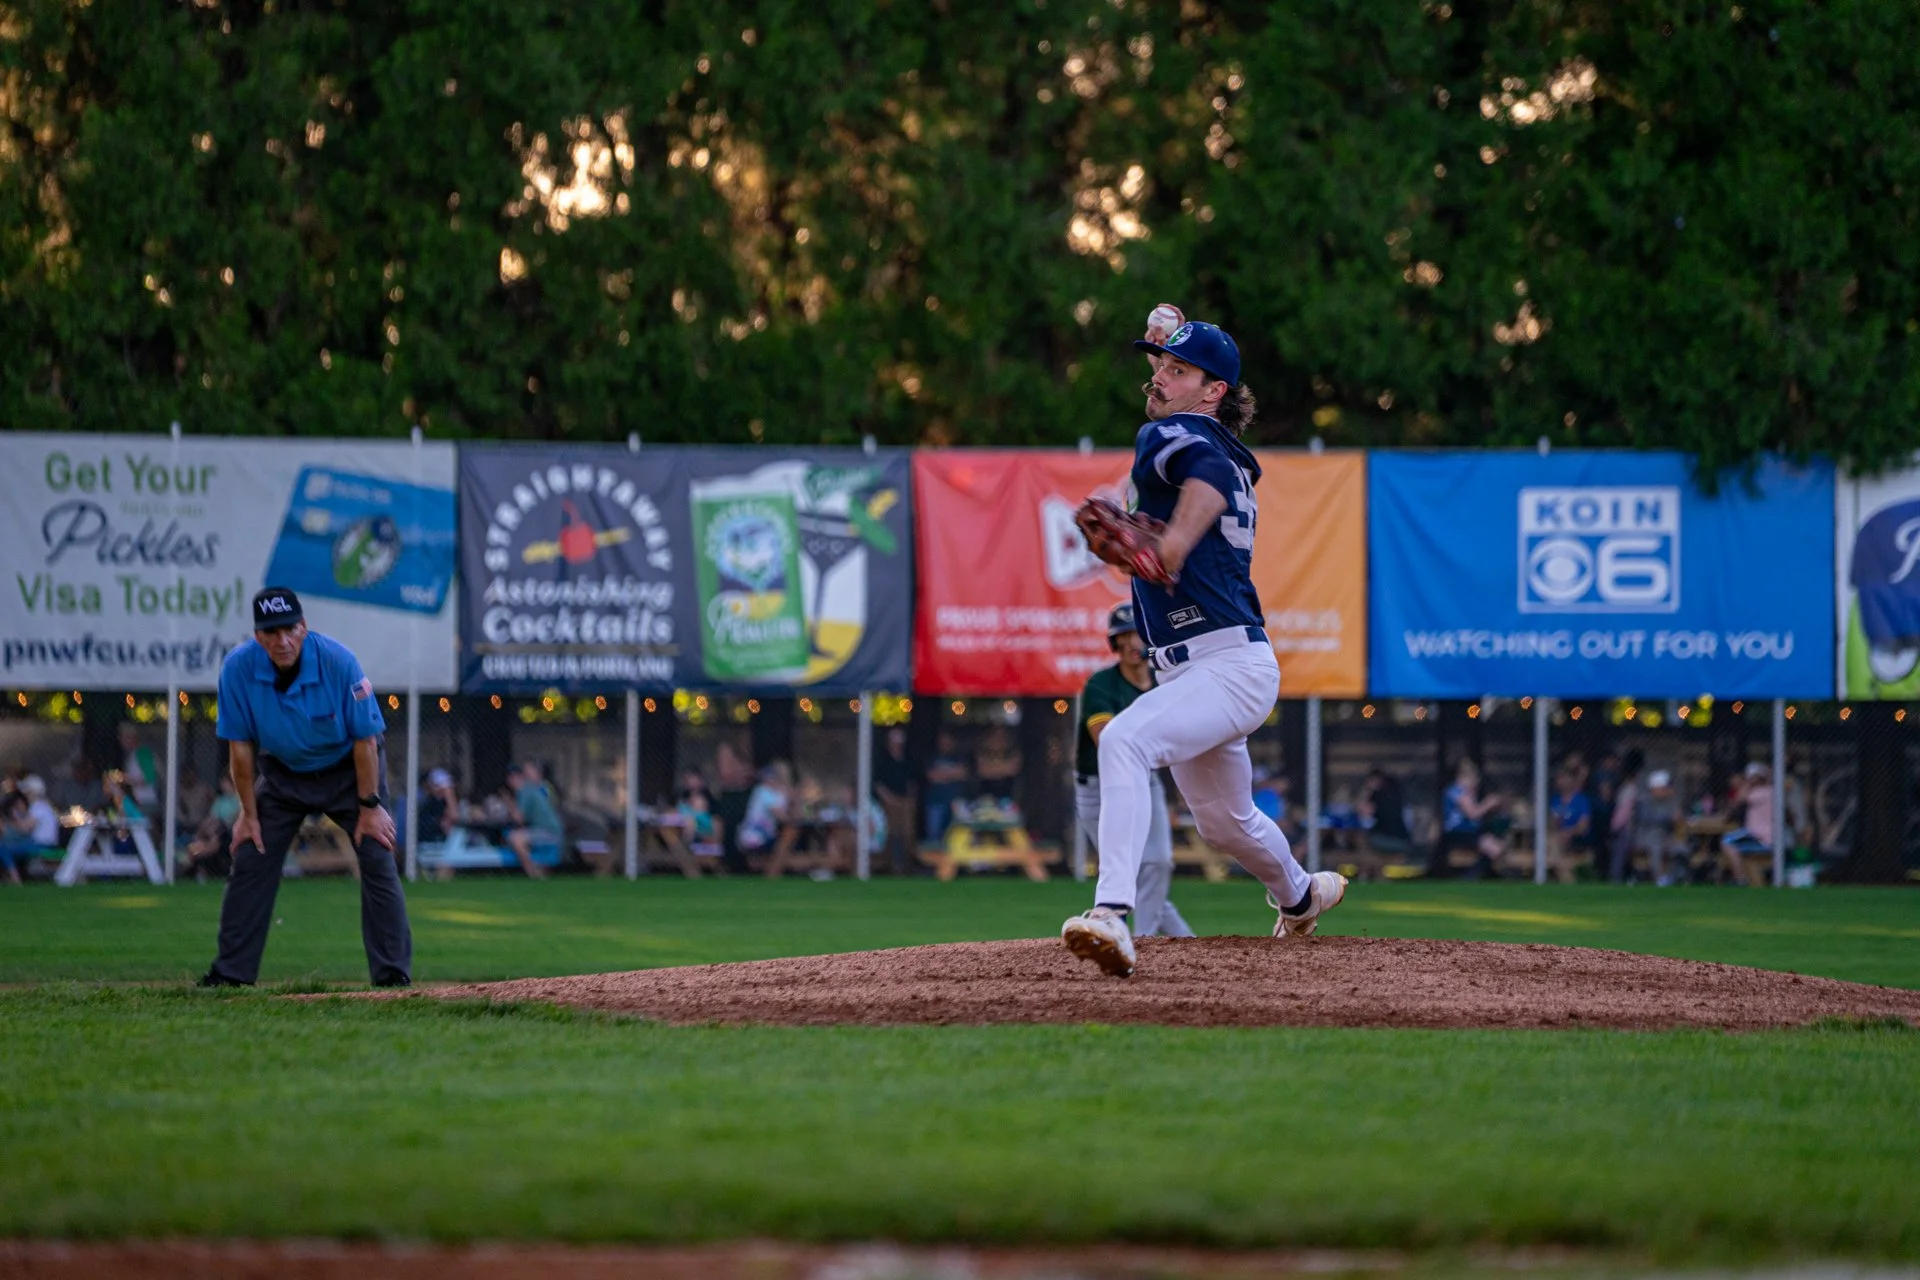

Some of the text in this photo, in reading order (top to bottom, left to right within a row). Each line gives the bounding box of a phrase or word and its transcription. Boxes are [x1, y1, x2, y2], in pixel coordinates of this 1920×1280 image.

[45, 452, 218, 495] Get Your
[484, 463, 673, 572] STRAIGHTAWAY
[1536, 498, 1663, 526] KOIN
[41, 499, 220, 569] Pickles
[1596, 537, 1670, 604] 6
[17, 573, 244, 626] Visa Today!
[483, 574, 675, 612] Astonishing
[483, 605, 675, 645] Cocktails
[1404, 629, 1794, 660] WATCHING OUT FOR YOU
